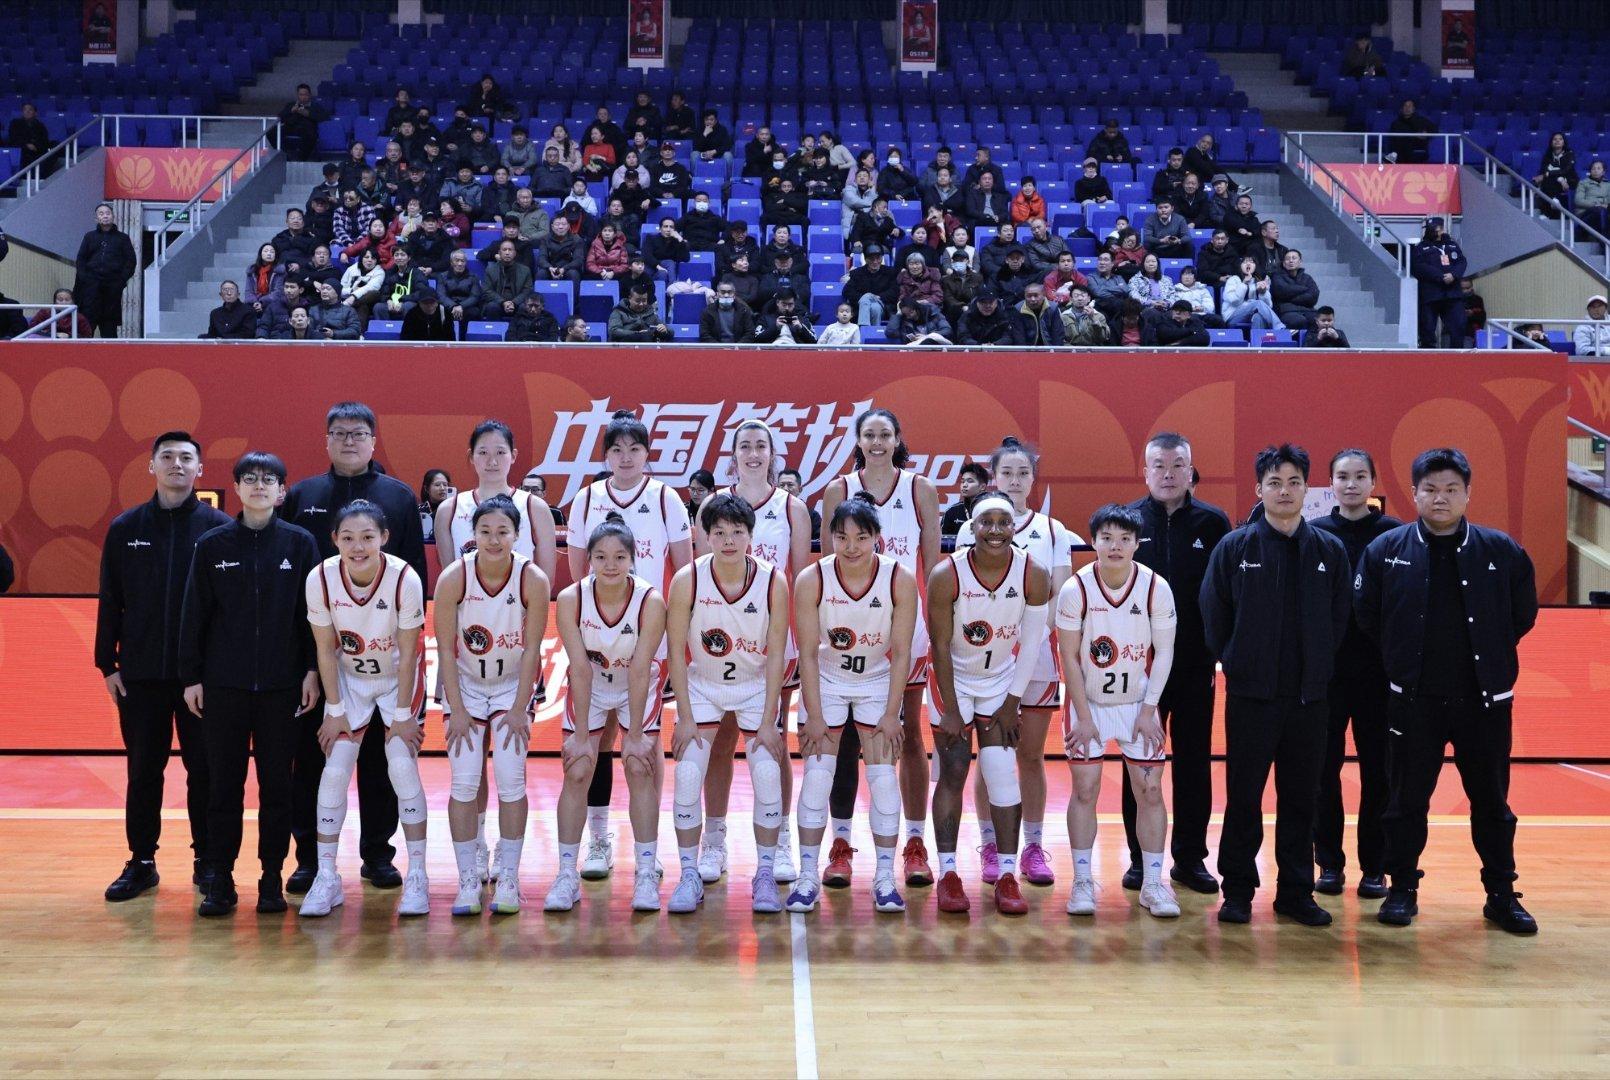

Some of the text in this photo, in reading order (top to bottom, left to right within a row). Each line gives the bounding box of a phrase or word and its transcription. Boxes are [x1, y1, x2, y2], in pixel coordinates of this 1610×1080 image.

[352, 658, 381, 675] 23
[478, 659, 504, 679] 11
[841, 655, 866, 674] 30
[983, 650, 993, 670] 1
[601, 672, 613, 684] 4
[722, 662, 736, 681] 2
[1102, 673, 1130, 694] 21
